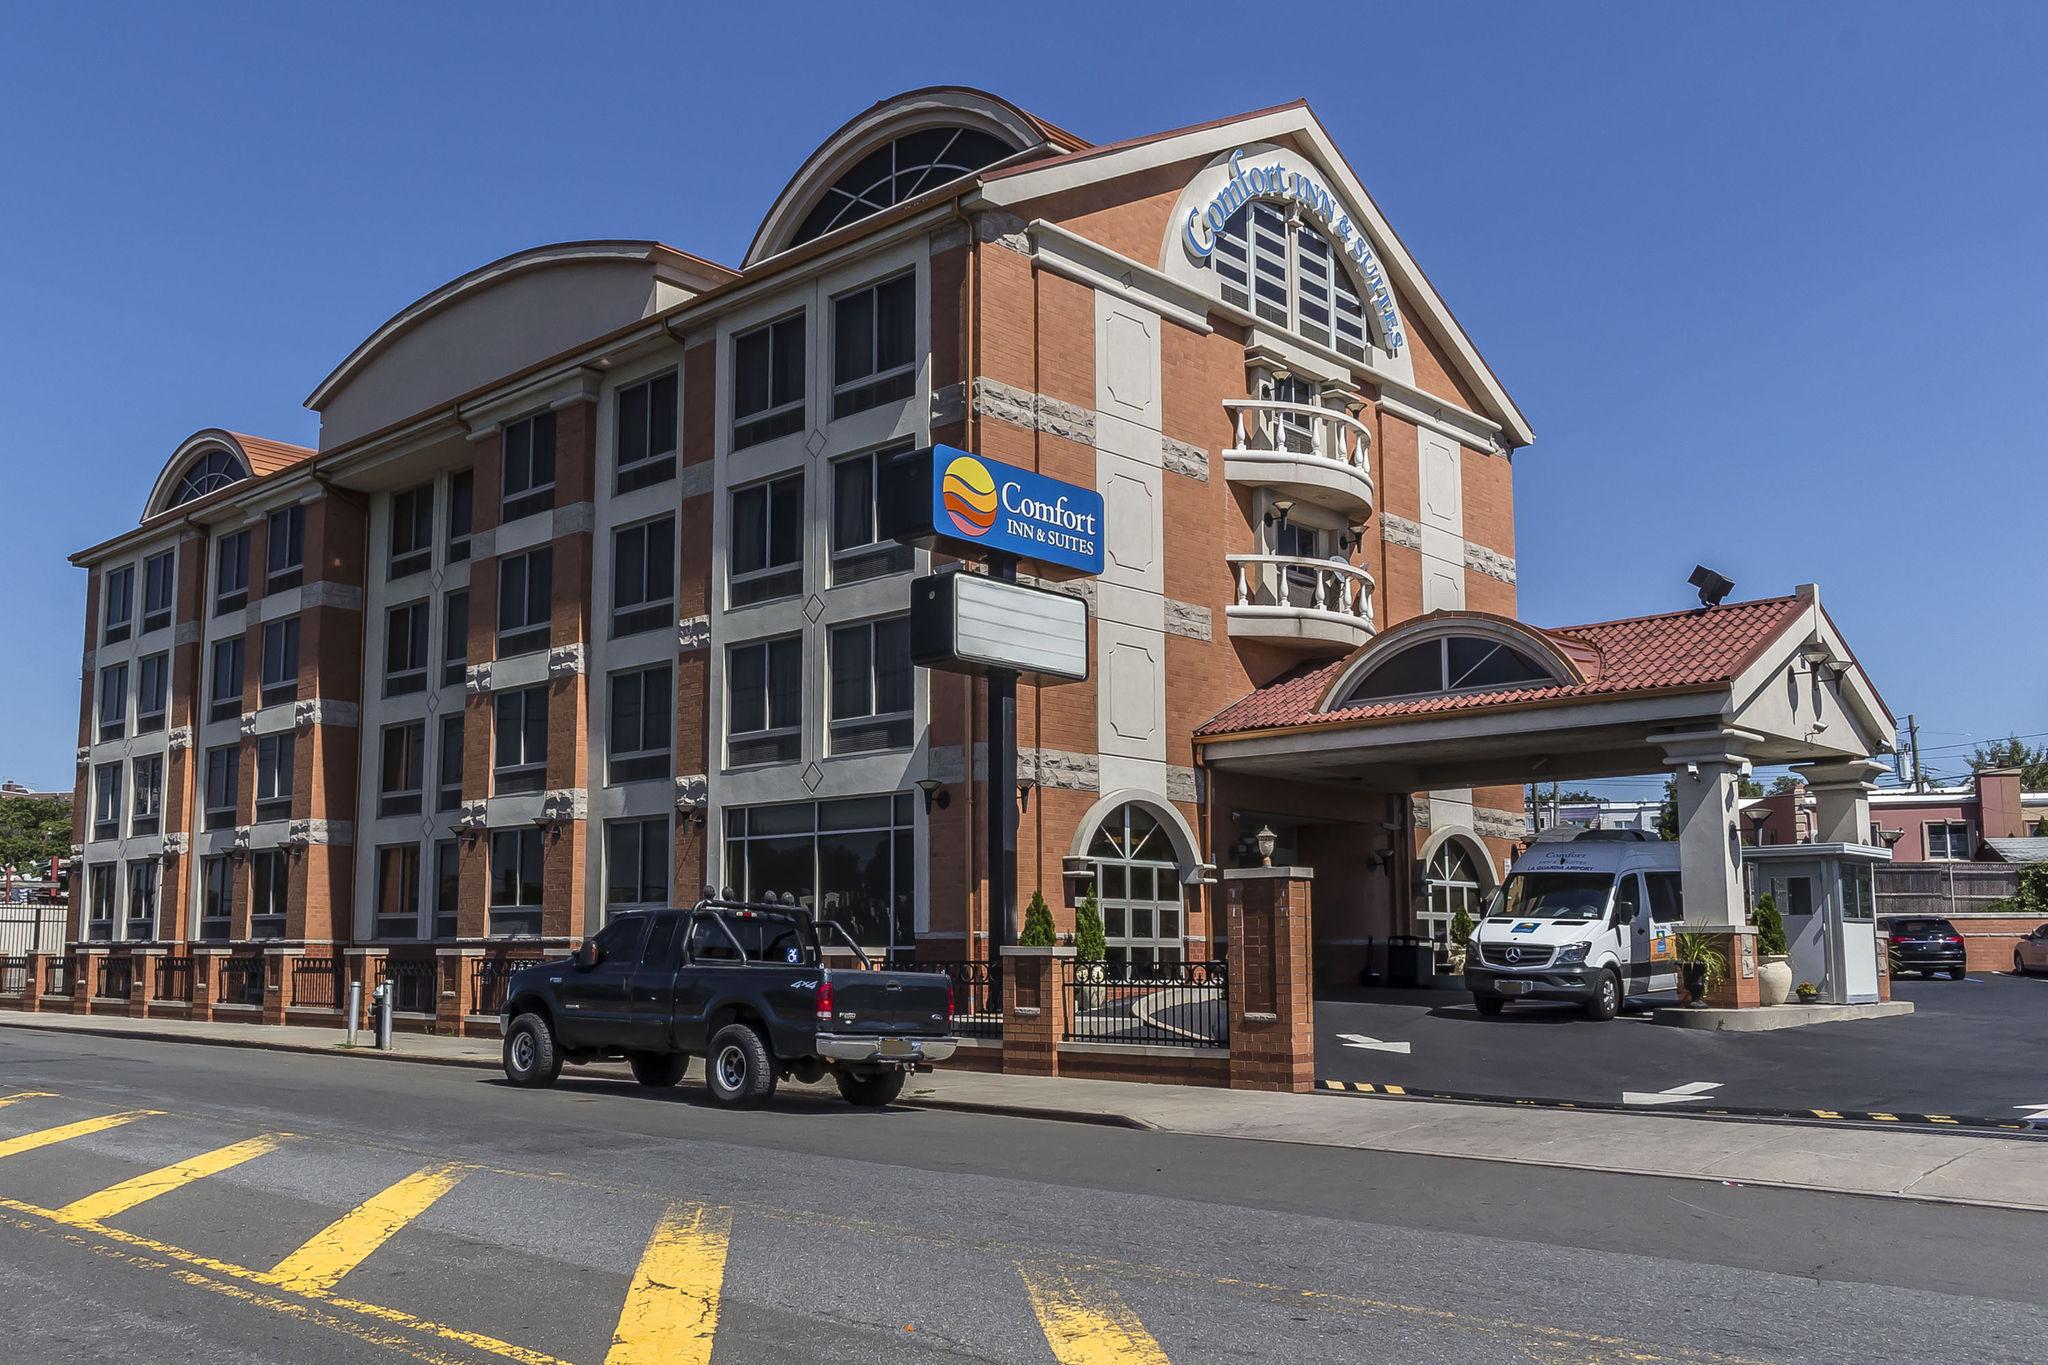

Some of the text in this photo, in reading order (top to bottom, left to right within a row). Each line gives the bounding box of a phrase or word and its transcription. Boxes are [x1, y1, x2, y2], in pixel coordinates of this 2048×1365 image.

[1184, 149, 1404, 349] Comfort INN & SUITES
[1002, 482, 1096, 535] Comfort
[1007, 518, 1094, 556] INN & SUITES
